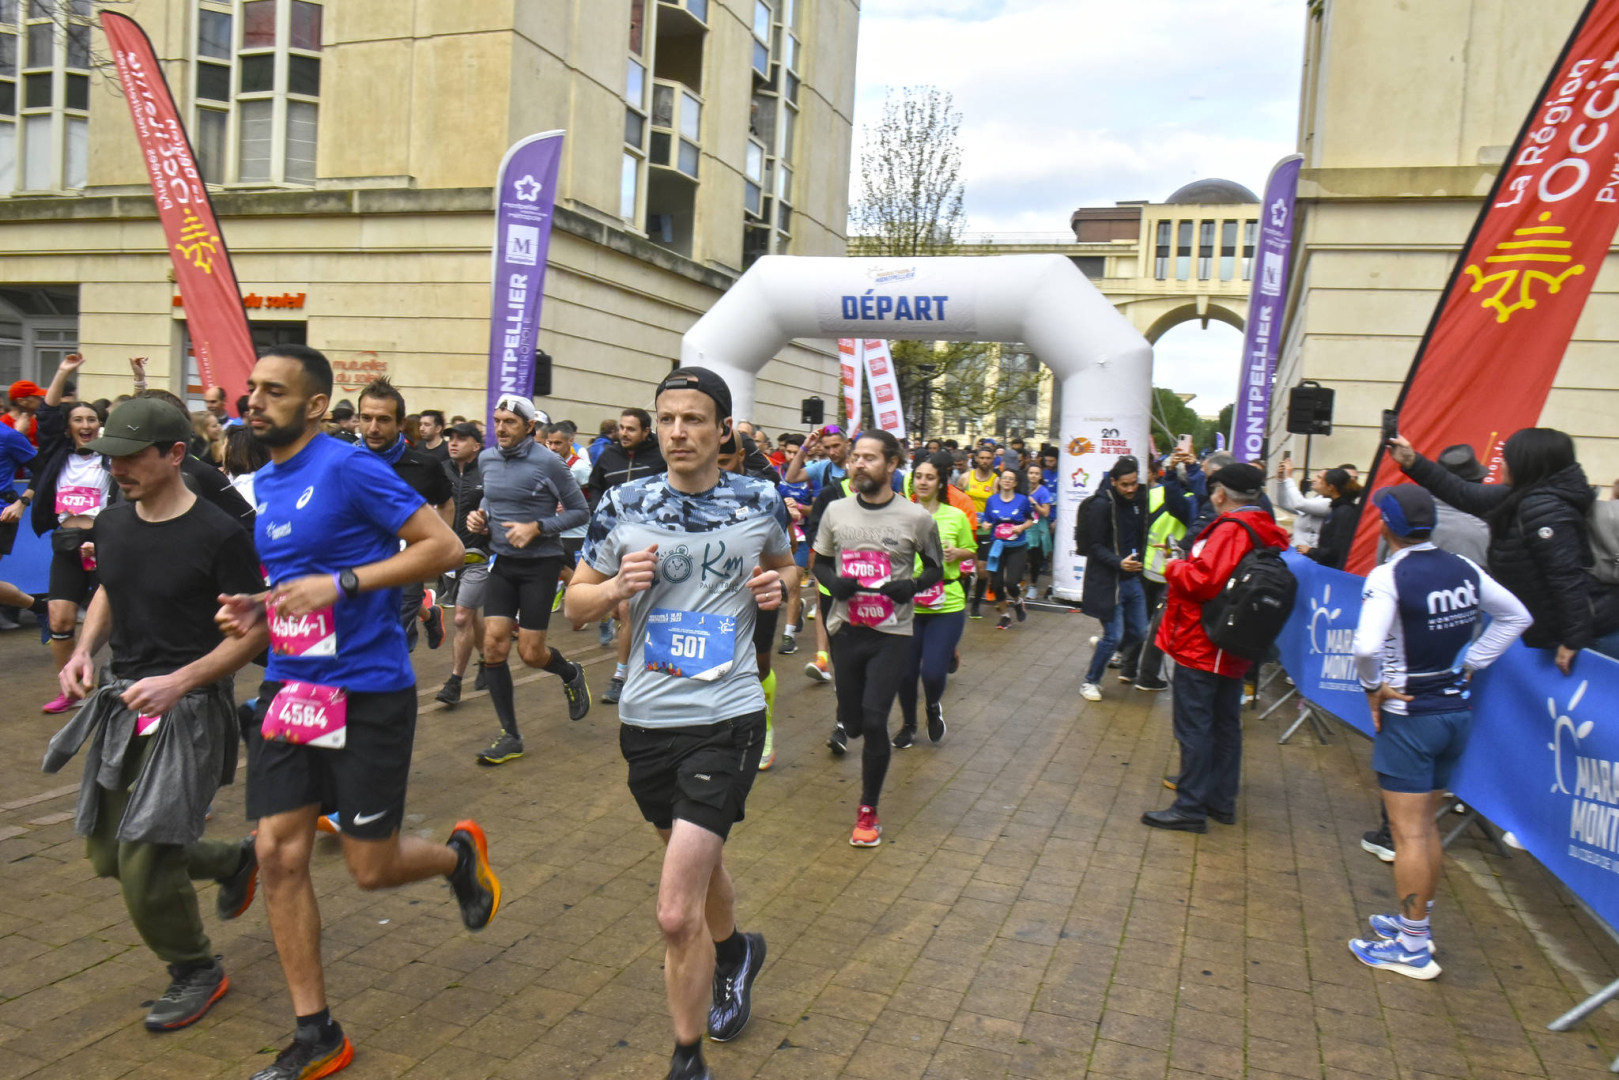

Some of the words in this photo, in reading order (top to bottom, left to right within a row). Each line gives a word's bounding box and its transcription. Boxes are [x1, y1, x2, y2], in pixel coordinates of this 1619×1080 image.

[1494, 174, 1534, 208] La
[1516, 58, 1597, 166] Région
[264, 292, 307, 310] soleil
[841, 288, 948, 321] DÉPART
[500, 273, 528, 393] NTPELLIER
[332, 358, 388, 371] mutuelles
[335, 371, 351, 383] du
[1100, 439, 1128, 447] TERRE
[1099, 446, 1112, 455] DE
[1112, 447, 1132, 455] JEUX
[61, 495, 95, 507] 4737-1
[846, 563, 885, 577] 4708-1
[1427, 578, 1480, 615] mat
[857, 606, 885, 618] 4708
[670, 633, 707, 660] 501
